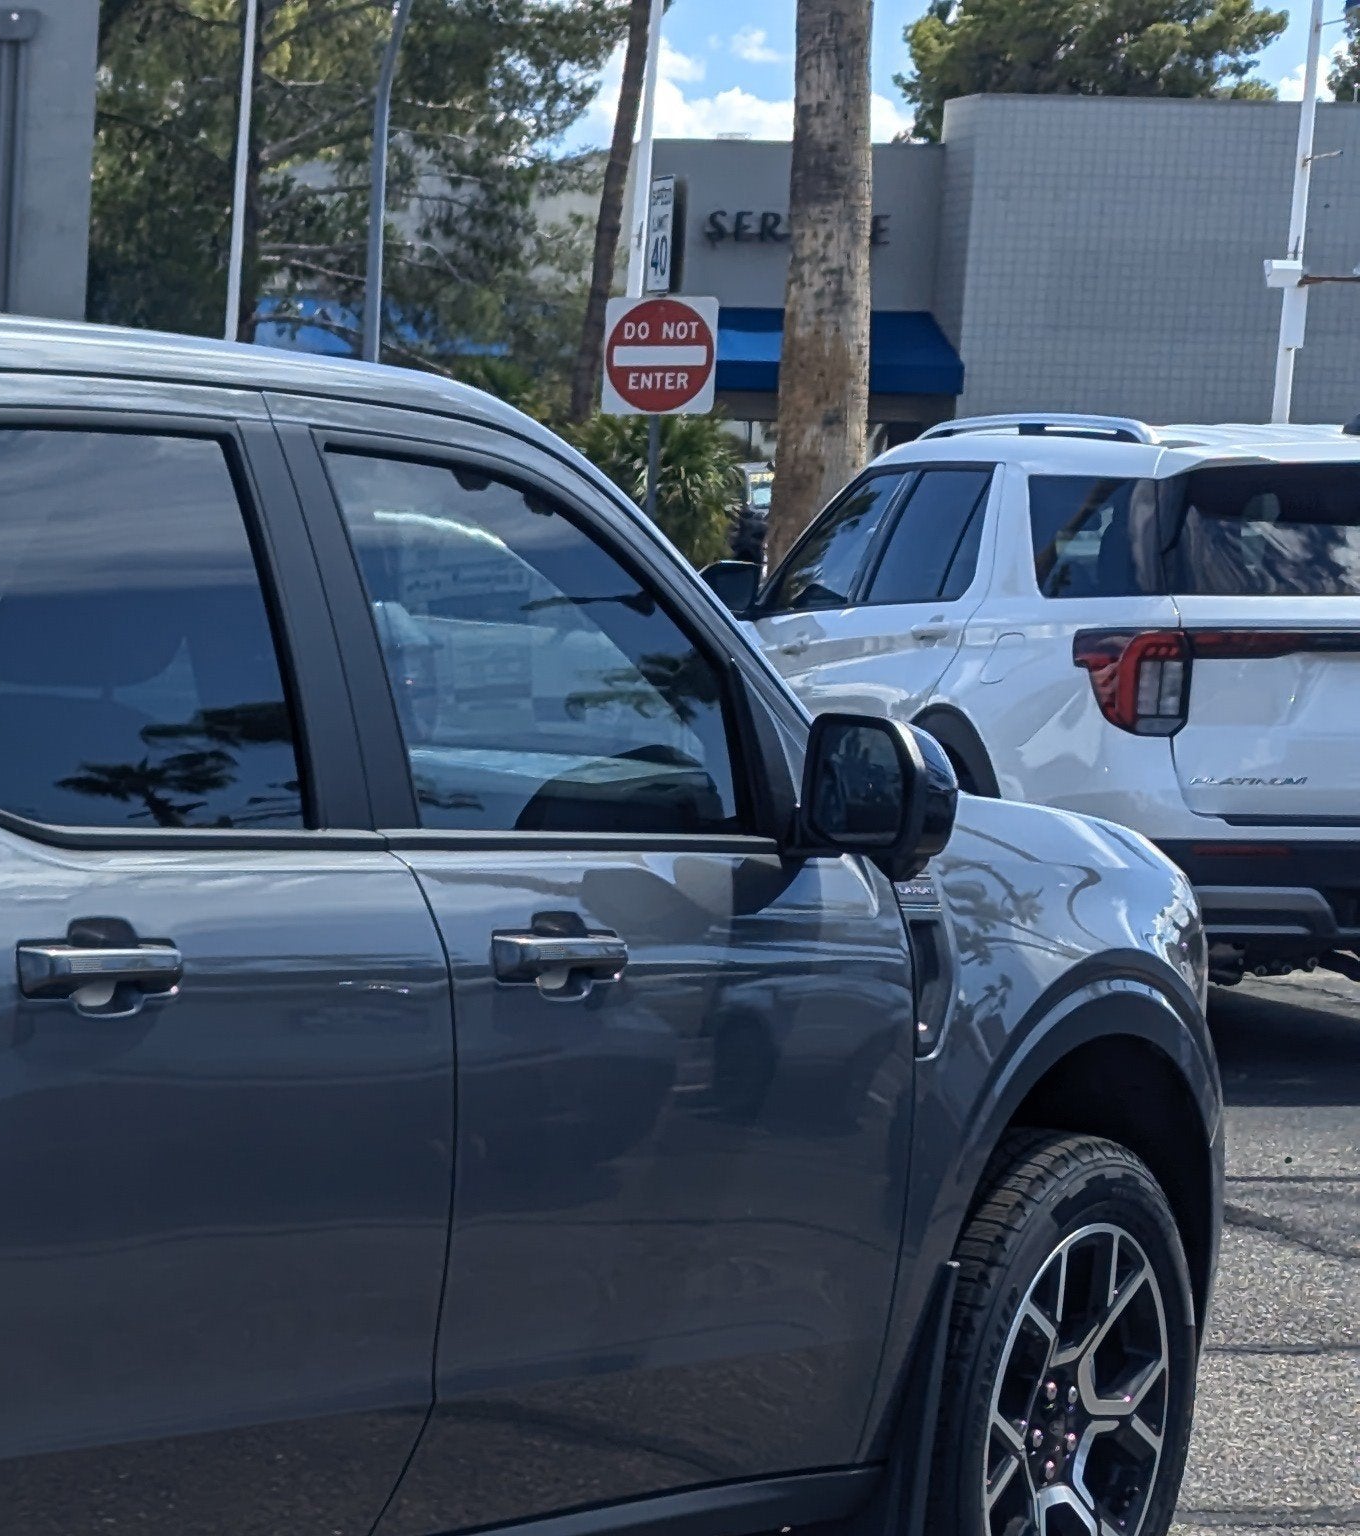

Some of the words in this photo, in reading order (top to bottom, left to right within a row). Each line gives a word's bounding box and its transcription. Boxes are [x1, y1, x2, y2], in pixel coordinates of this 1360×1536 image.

[706, 210, 891, 247] SERE
[651, 235, 668, 276] 40
[624, 322, 650, 340] DO
[662, 321, 699, 340] NOT
[628, 372, 689, 390] ENTER
